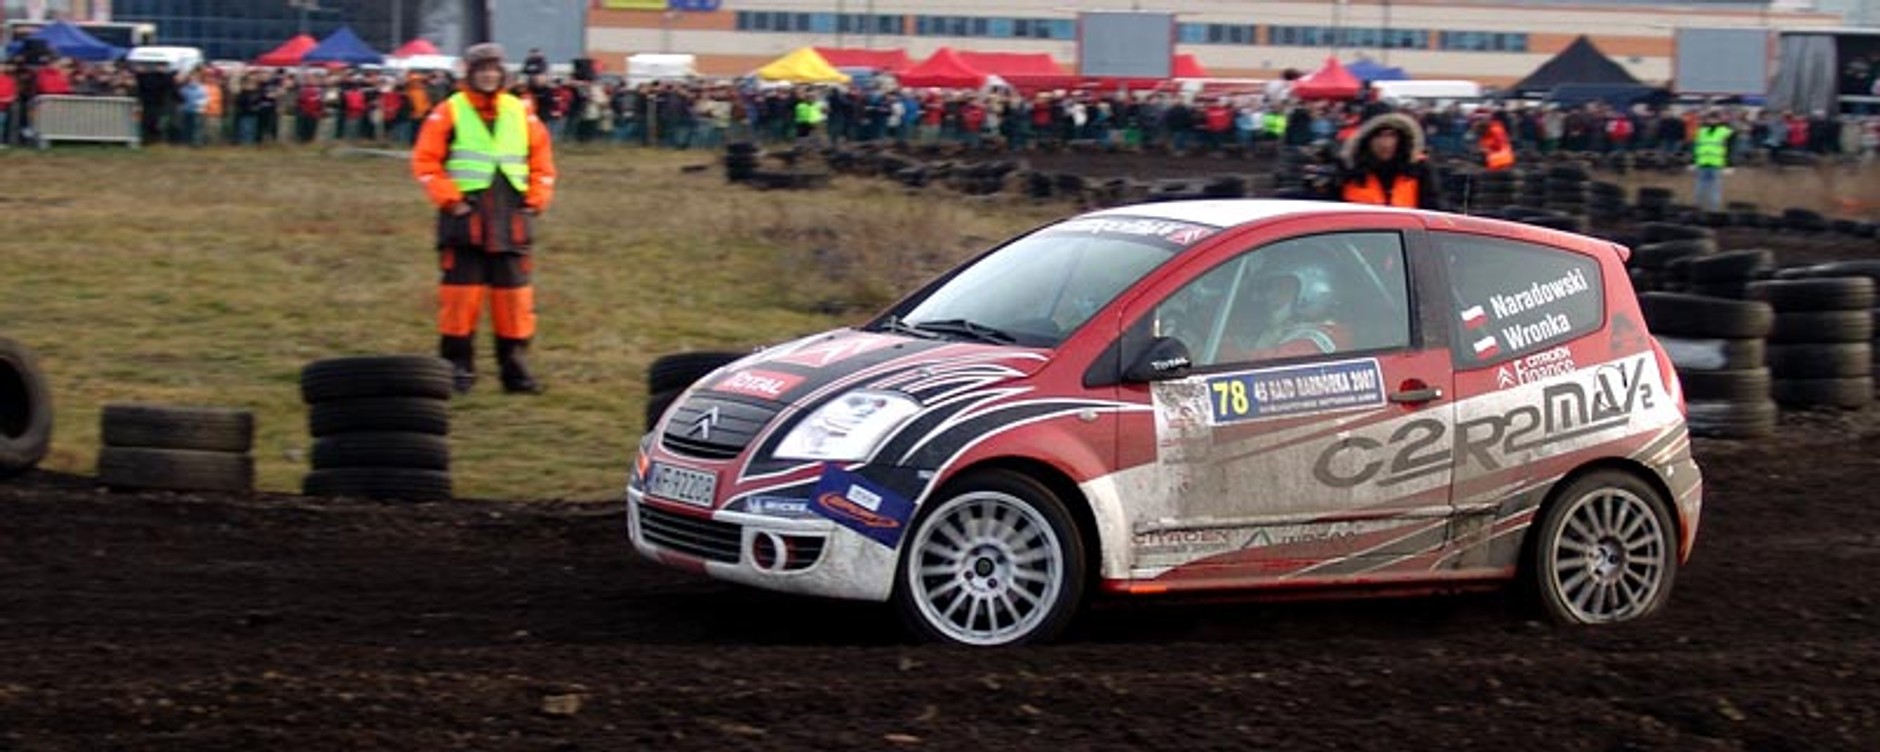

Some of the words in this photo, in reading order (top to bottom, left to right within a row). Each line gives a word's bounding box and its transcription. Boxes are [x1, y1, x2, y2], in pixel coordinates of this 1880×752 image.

[1490, 267, 1589, 319] Naradowski
[1502, 313, 1571, 350] Wronka
[1213, 381, 1248, 415] 78
